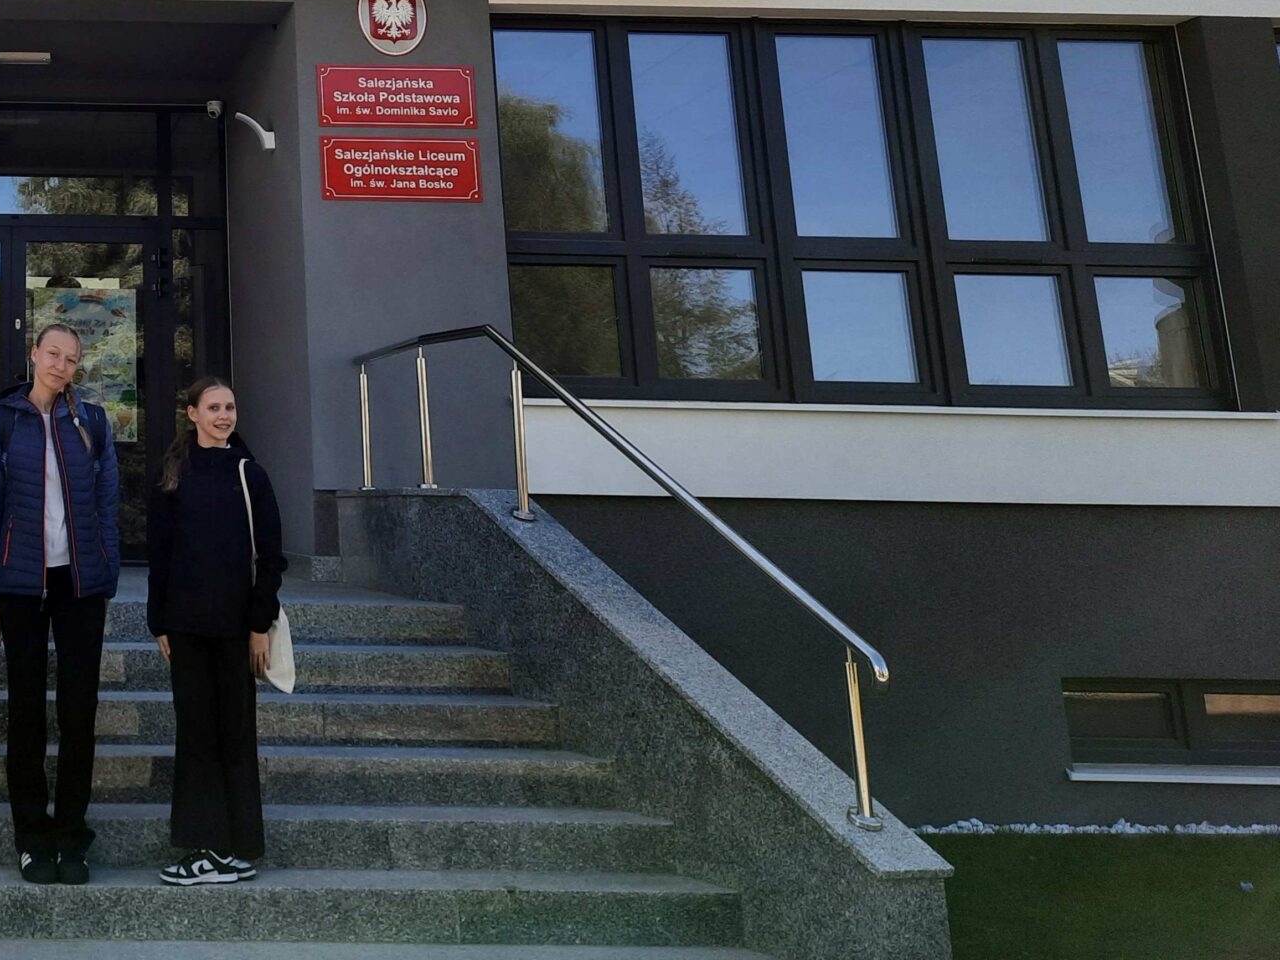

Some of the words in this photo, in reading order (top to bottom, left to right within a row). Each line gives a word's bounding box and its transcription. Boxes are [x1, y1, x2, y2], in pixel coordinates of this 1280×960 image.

[357, 77, 434, 90] Salezjańska
[333, 91, 376, 103] Szkoła
[378, 92, 461, 104] Podstawowa
[336, 105, 353, 115] im.
[355, 105, 373, 115] św.
[375, 106, 426, 116] Dominika
[428, 106, 459, 116] Savio
[334, 148, 415, 162] Salezjańskie
[418, 149, 466, 162] Liceum
[343, 163, 459, 178] Ogólnokształcące
[350, 178, 367, 188] im.
[369, 178, 387, 188] św.
[390, 179, 417, 189] Jana
[418, 179, 454, 189] Bosko
